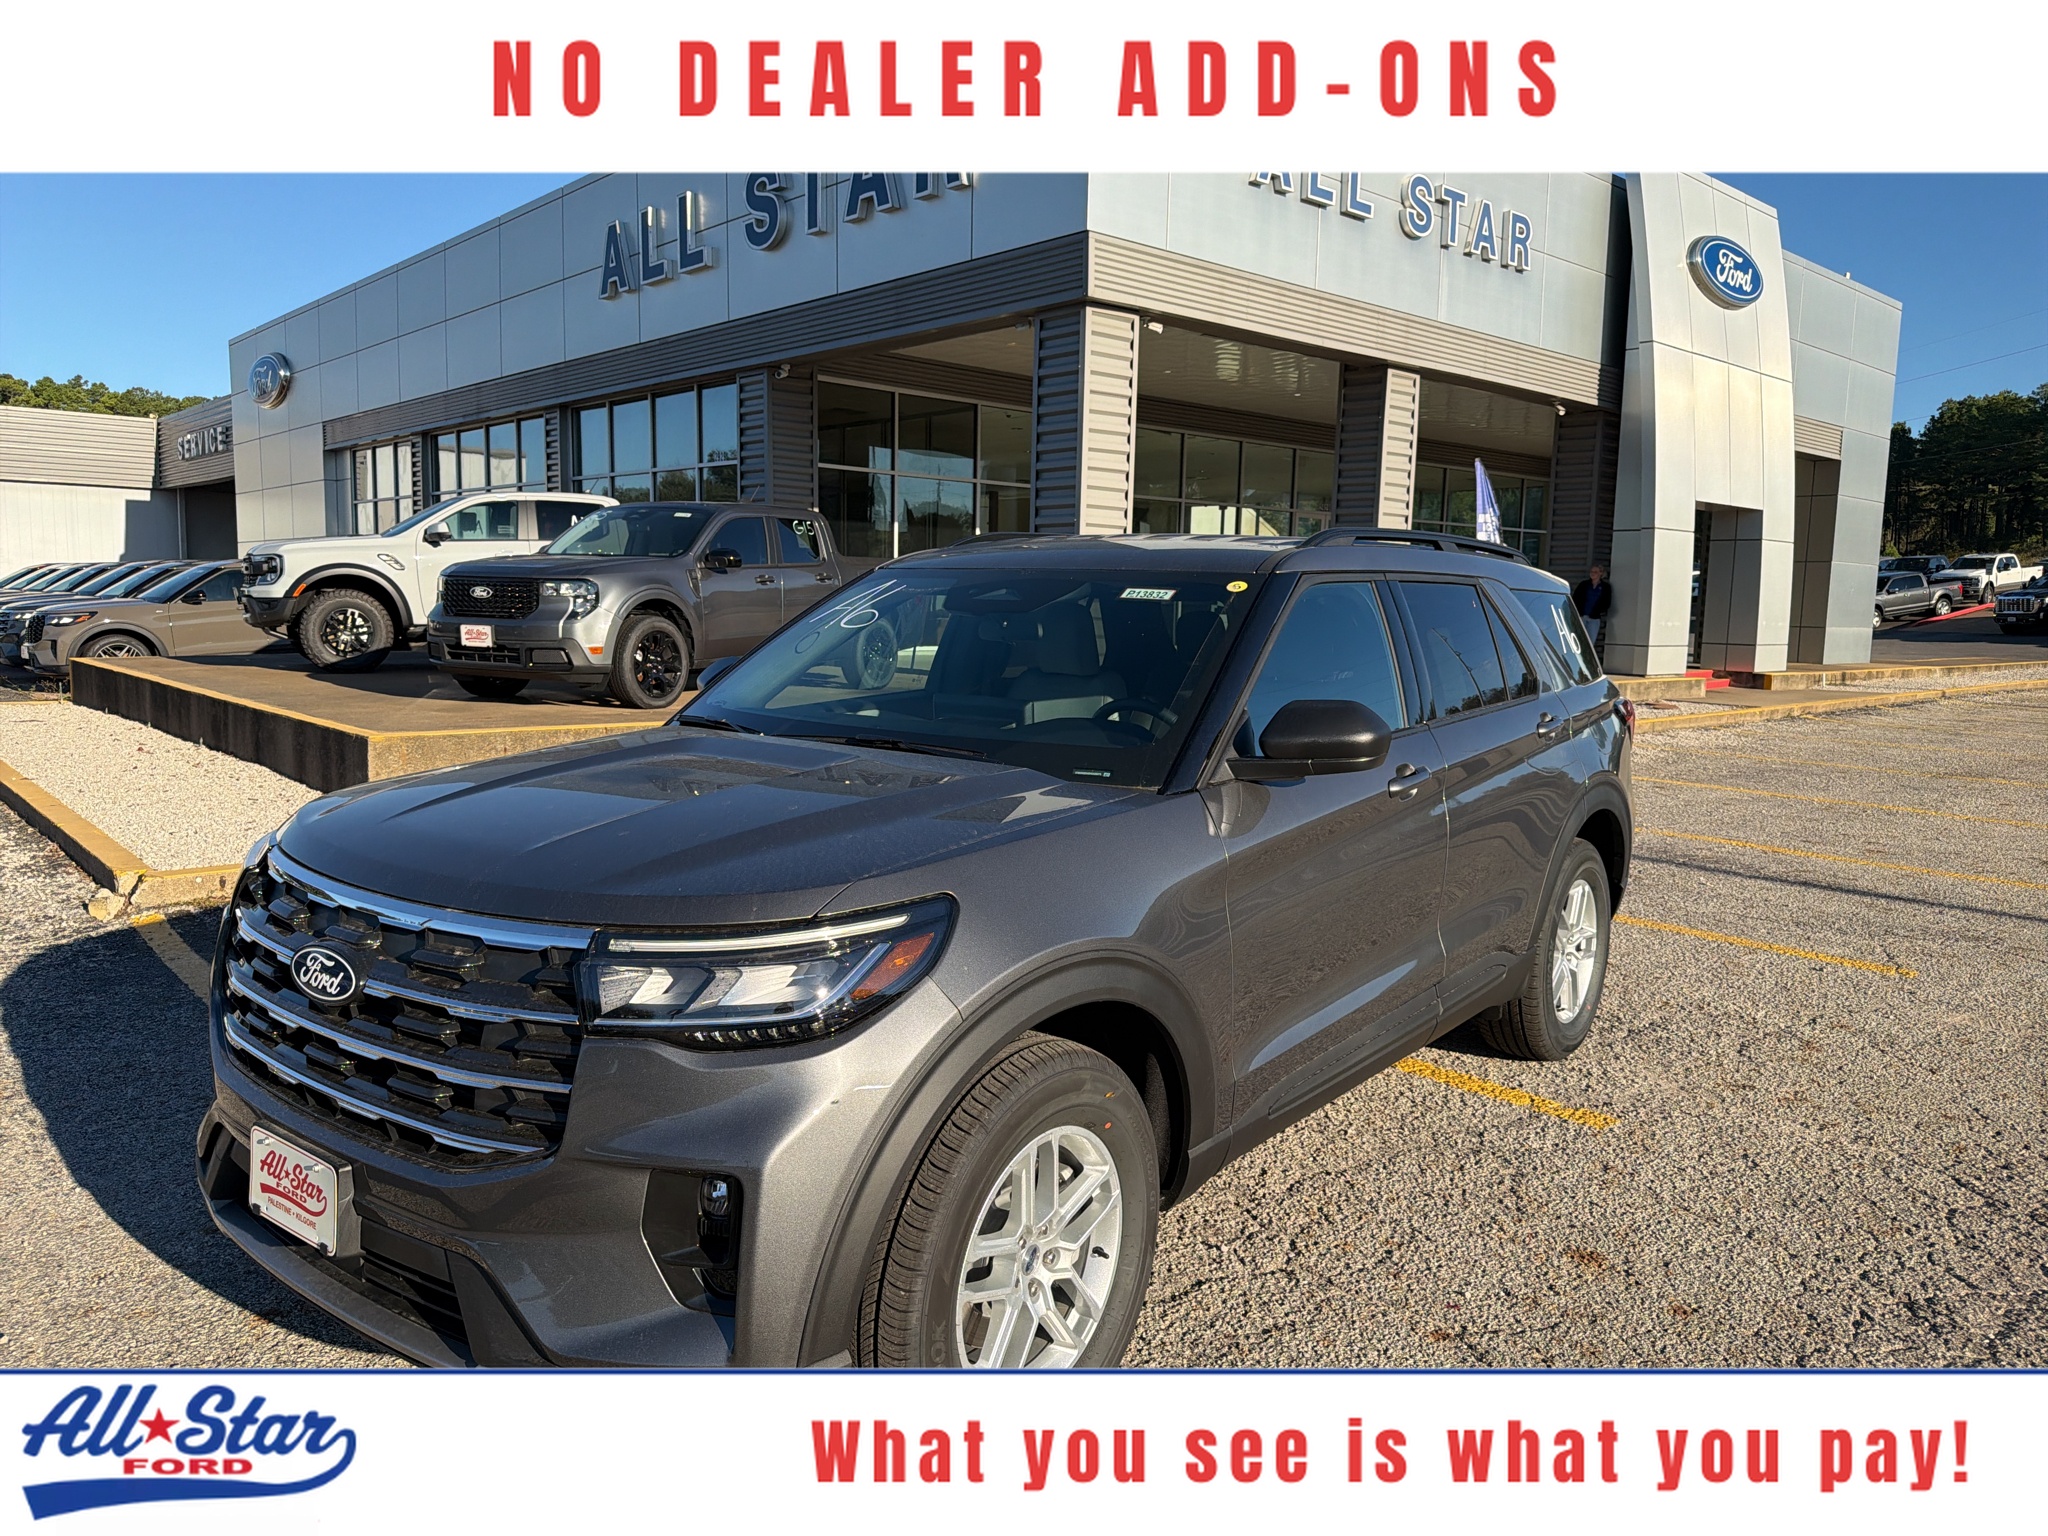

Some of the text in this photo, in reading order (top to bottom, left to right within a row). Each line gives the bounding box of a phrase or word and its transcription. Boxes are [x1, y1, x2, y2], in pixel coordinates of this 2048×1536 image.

[1399, 173, 1533, 273] STAR
[599, 189, 714, 300] ALL
[1716, 249, 1753, 292] Ford
[252, 366, 272, 398] Ford
[178, 426, 226, 460] SERVICE
[300, 953, 344, 994] Ford
[260, 1150, 327, 1204] All Star
[276, 1181, 307, 1204] FORD
[267, 1196, 317, 1230] PALESTINE KILGORE
